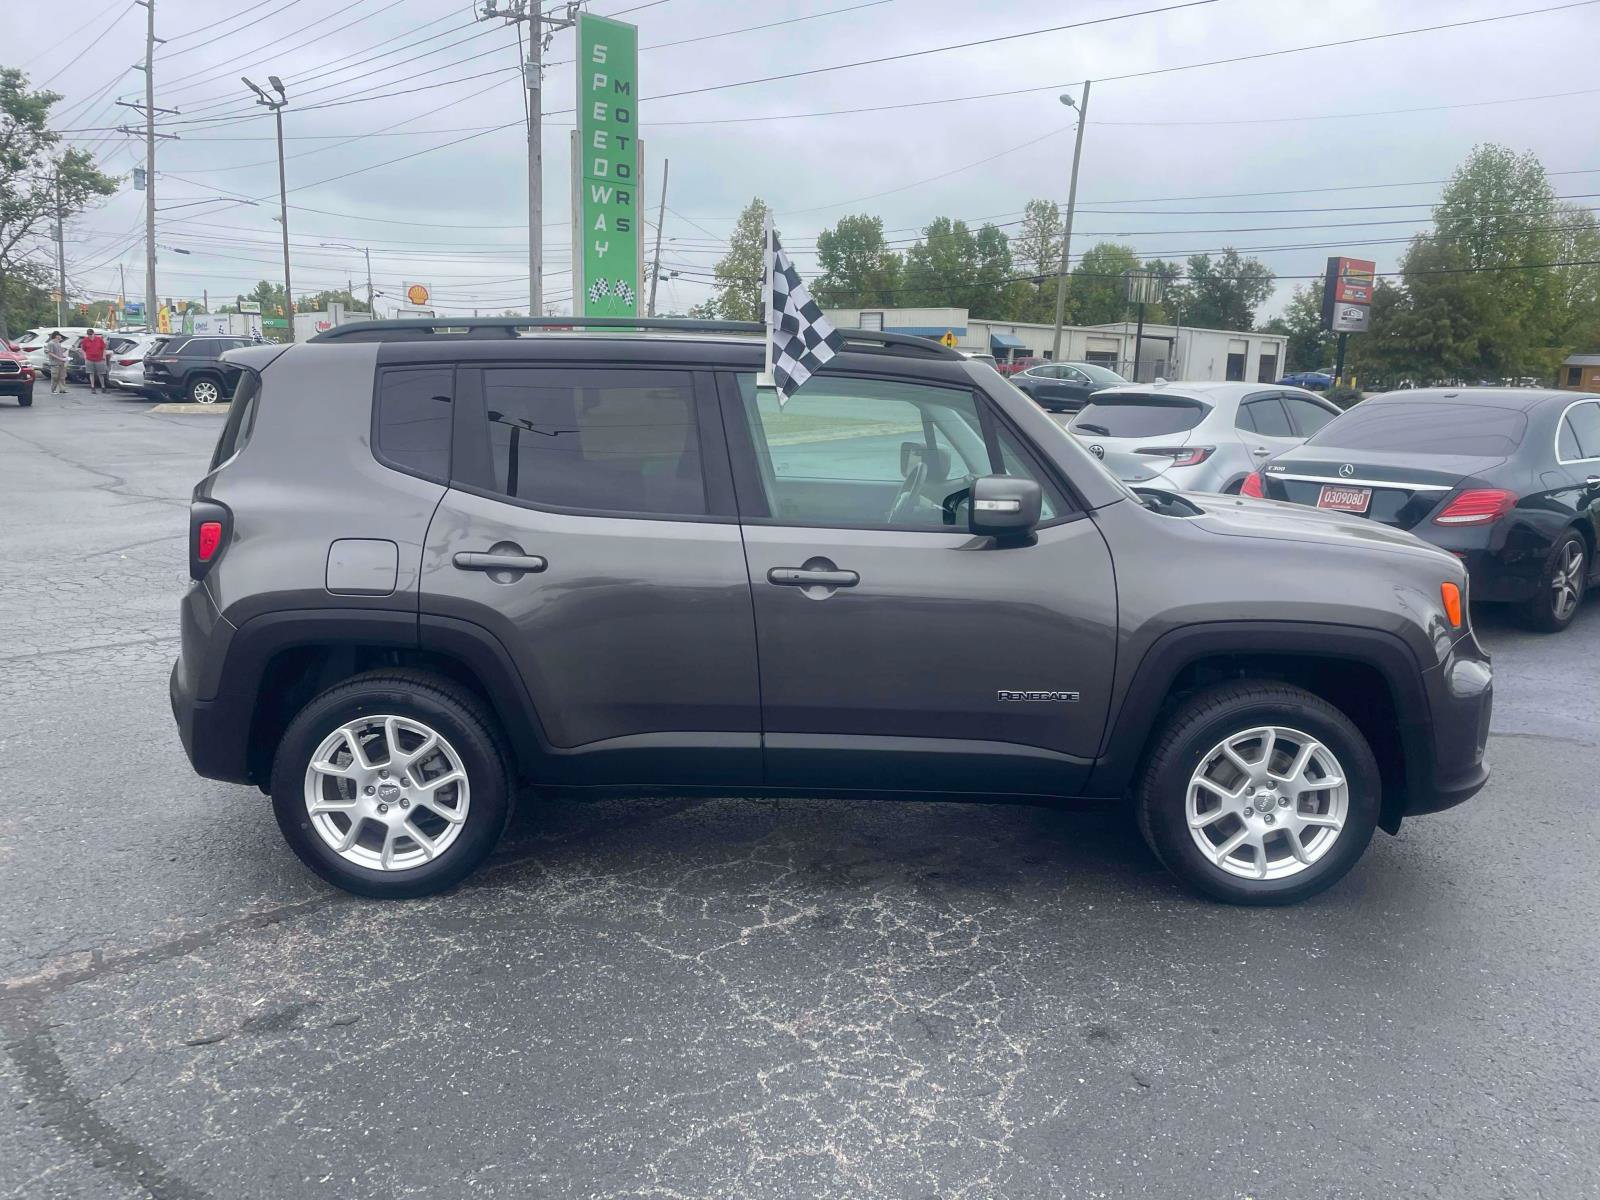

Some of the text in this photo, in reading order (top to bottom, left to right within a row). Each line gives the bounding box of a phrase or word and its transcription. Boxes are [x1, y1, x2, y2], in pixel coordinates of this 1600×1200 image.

[591, 44, 613, 258] SPEEDWAY
[614, 79, 630, 232] MOTORS
[997, 690, 1079, 702] RENEGADE
